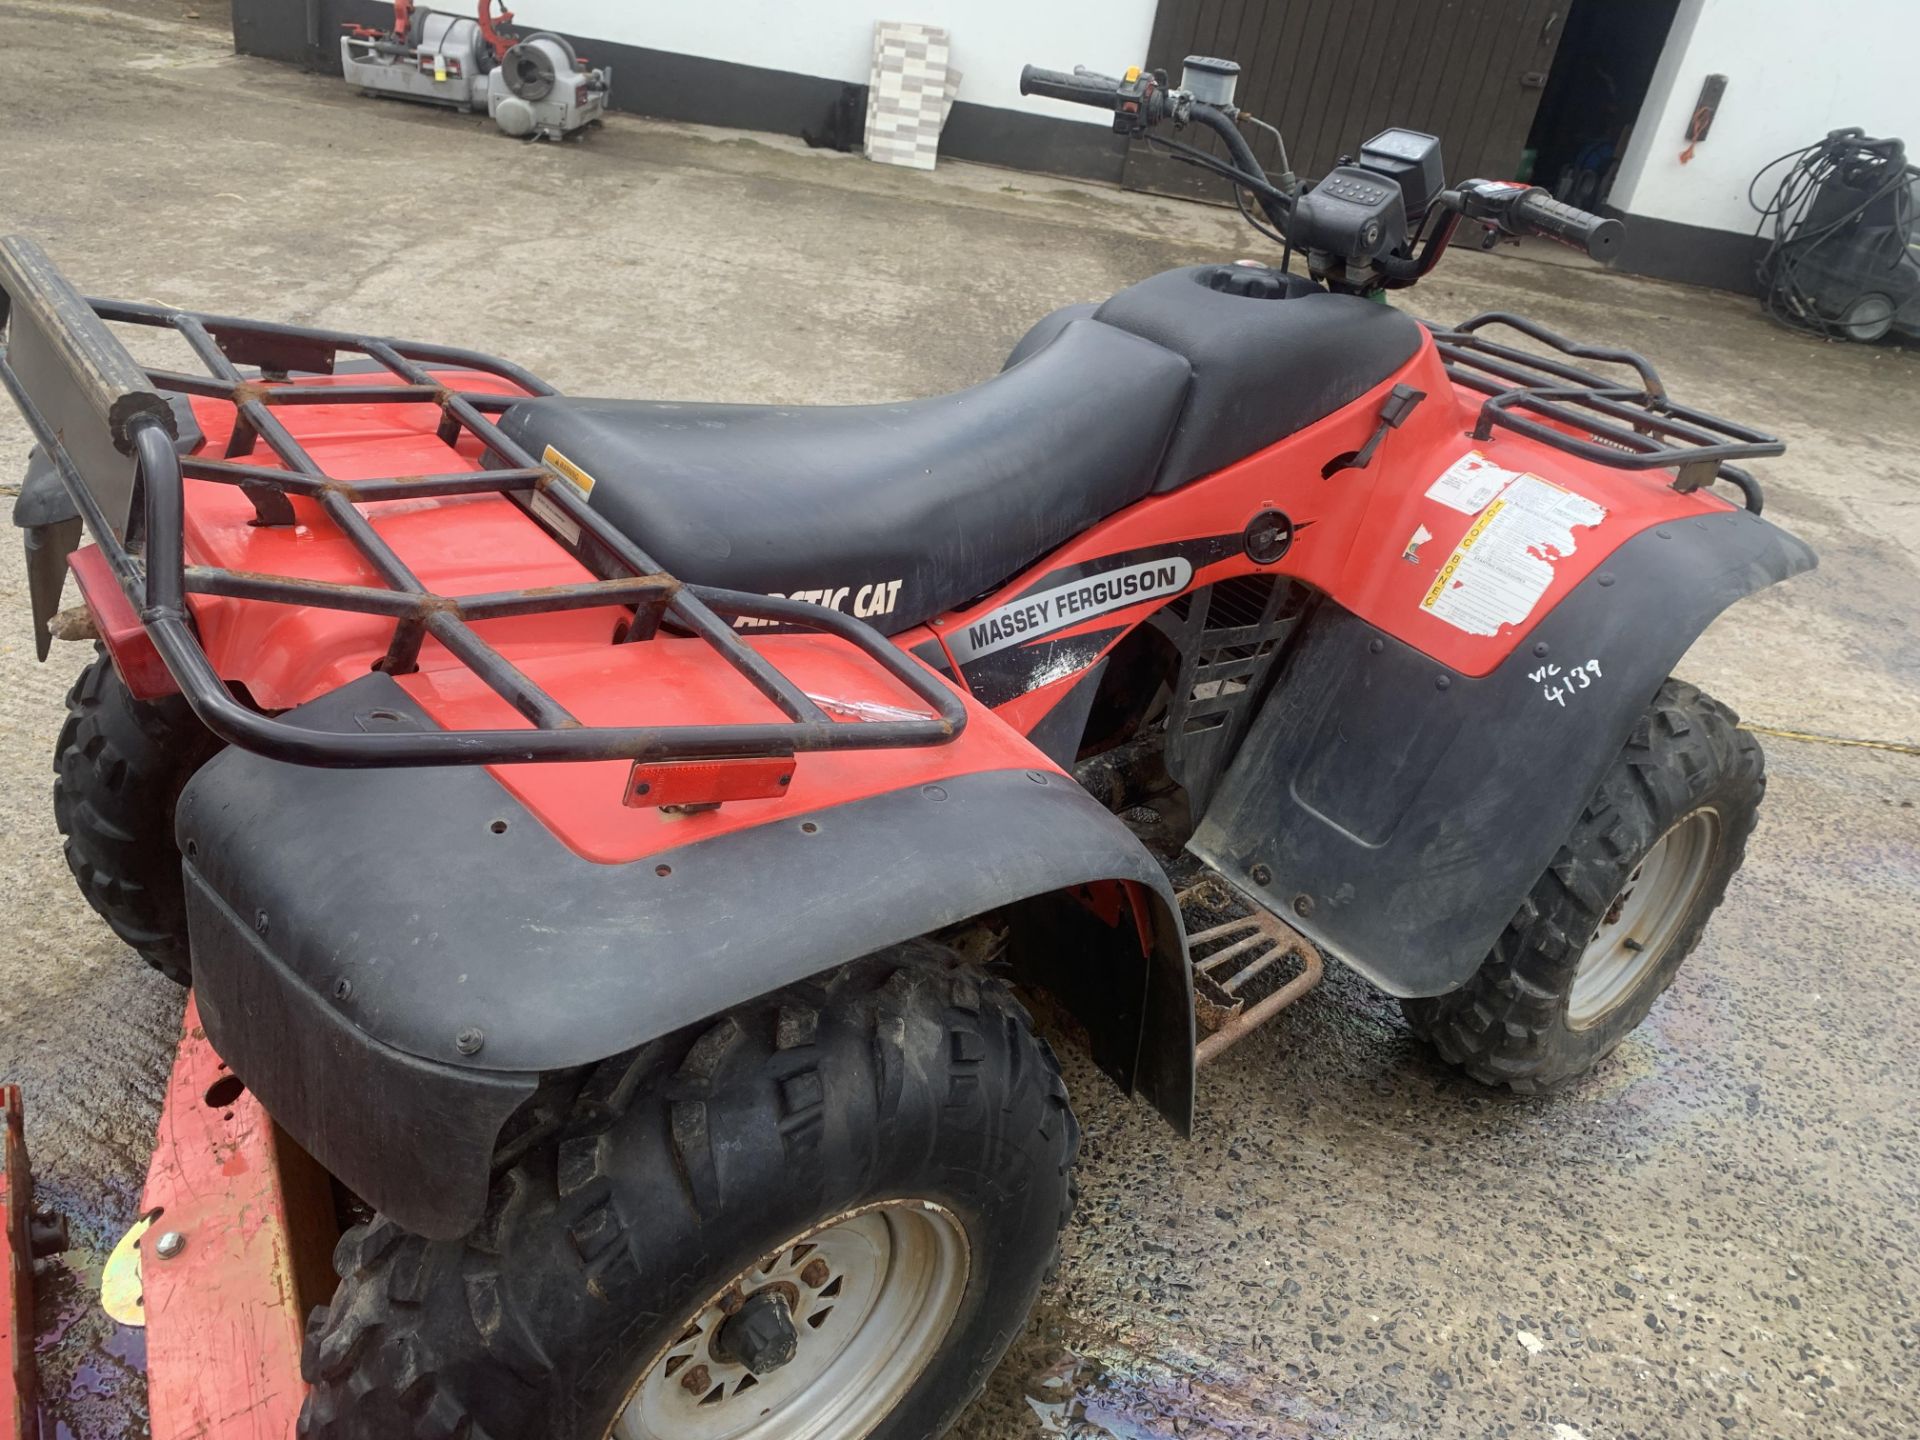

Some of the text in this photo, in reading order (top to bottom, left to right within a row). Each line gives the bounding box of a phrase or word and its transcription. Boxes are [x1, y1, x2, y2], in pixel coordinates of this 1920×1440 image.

[853, 579, 903, 618] CAT
[969, 566, 1176, 650] MASSEY FERGUSON
[1544, 659, 1602, 707] 4139
